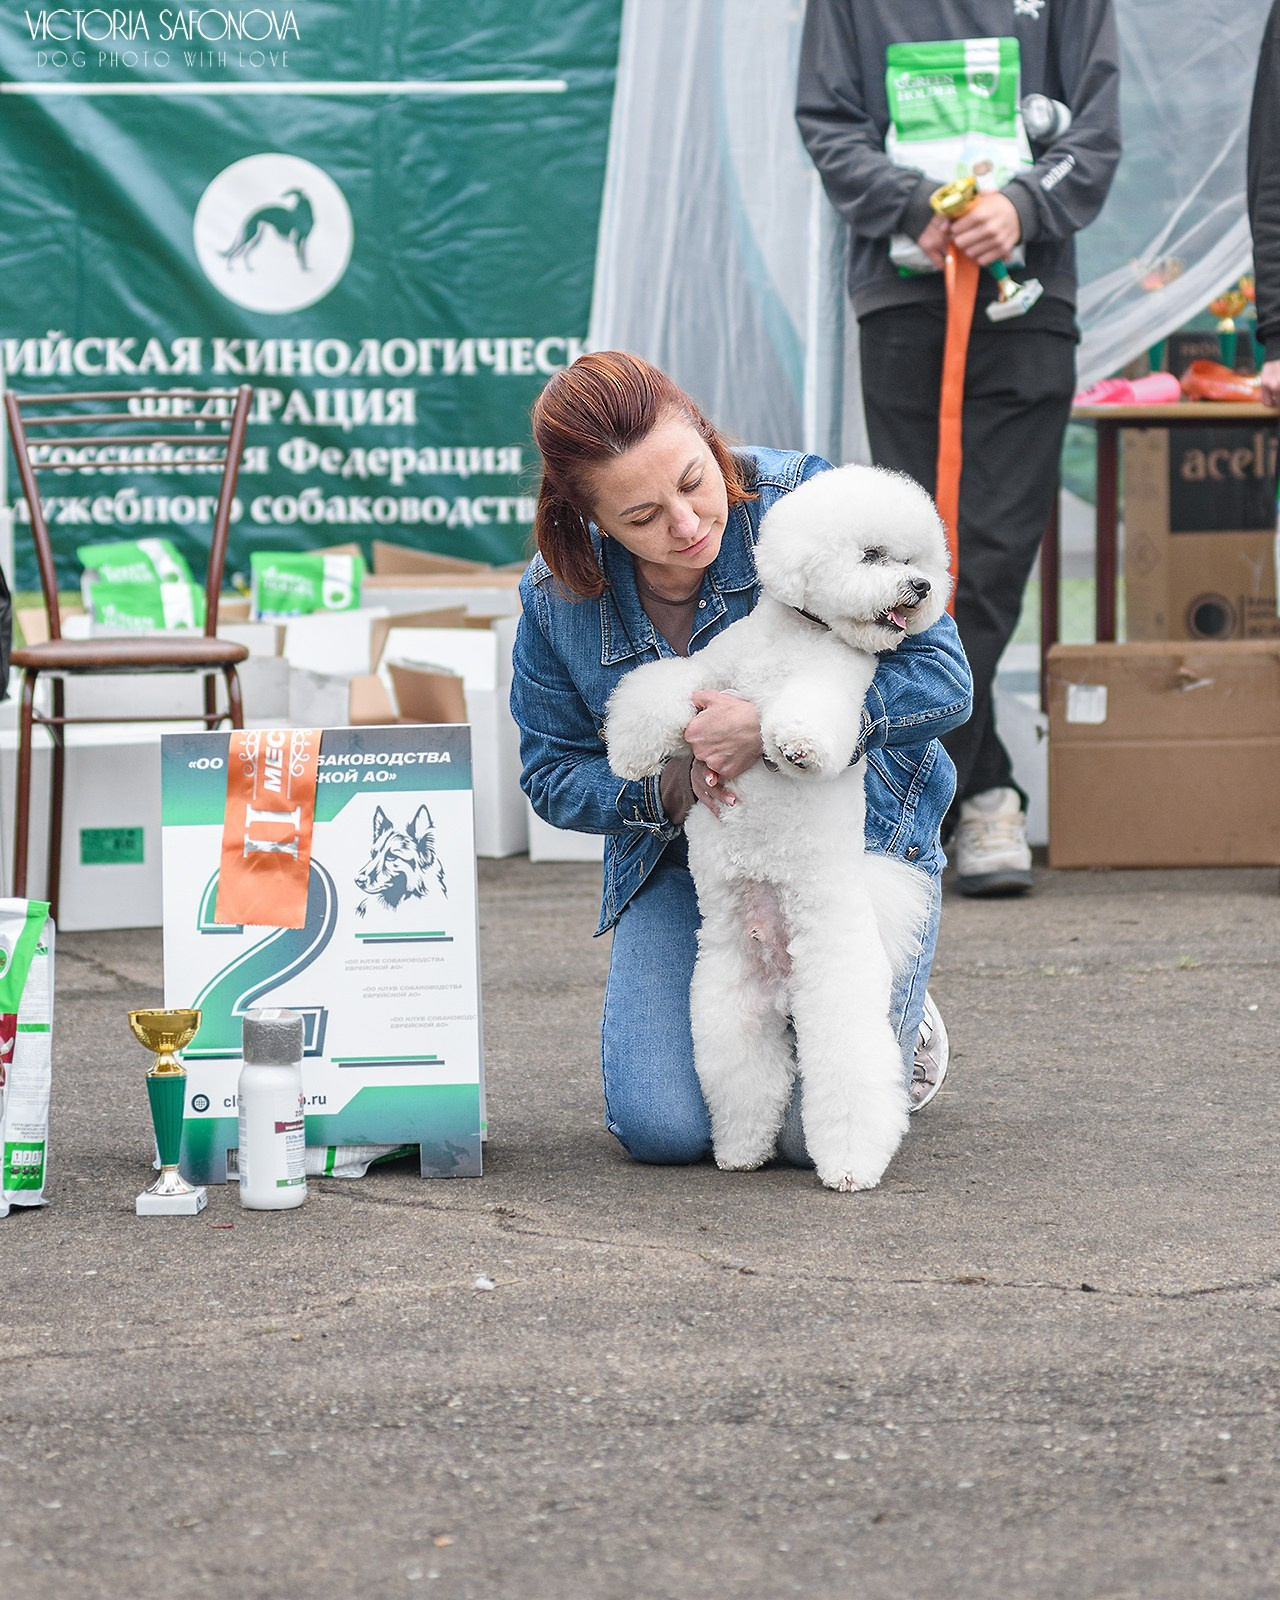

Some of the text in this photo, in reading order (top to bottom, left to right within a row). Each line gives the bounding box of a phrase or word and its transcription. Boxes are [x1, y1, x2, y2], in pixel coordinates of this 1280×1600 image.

[127, 386, 417, 432] ФЕДРАЦИЯ
[277, 436, 523, 486] Федерация
[316, 769, 359, 783] КОЙ
